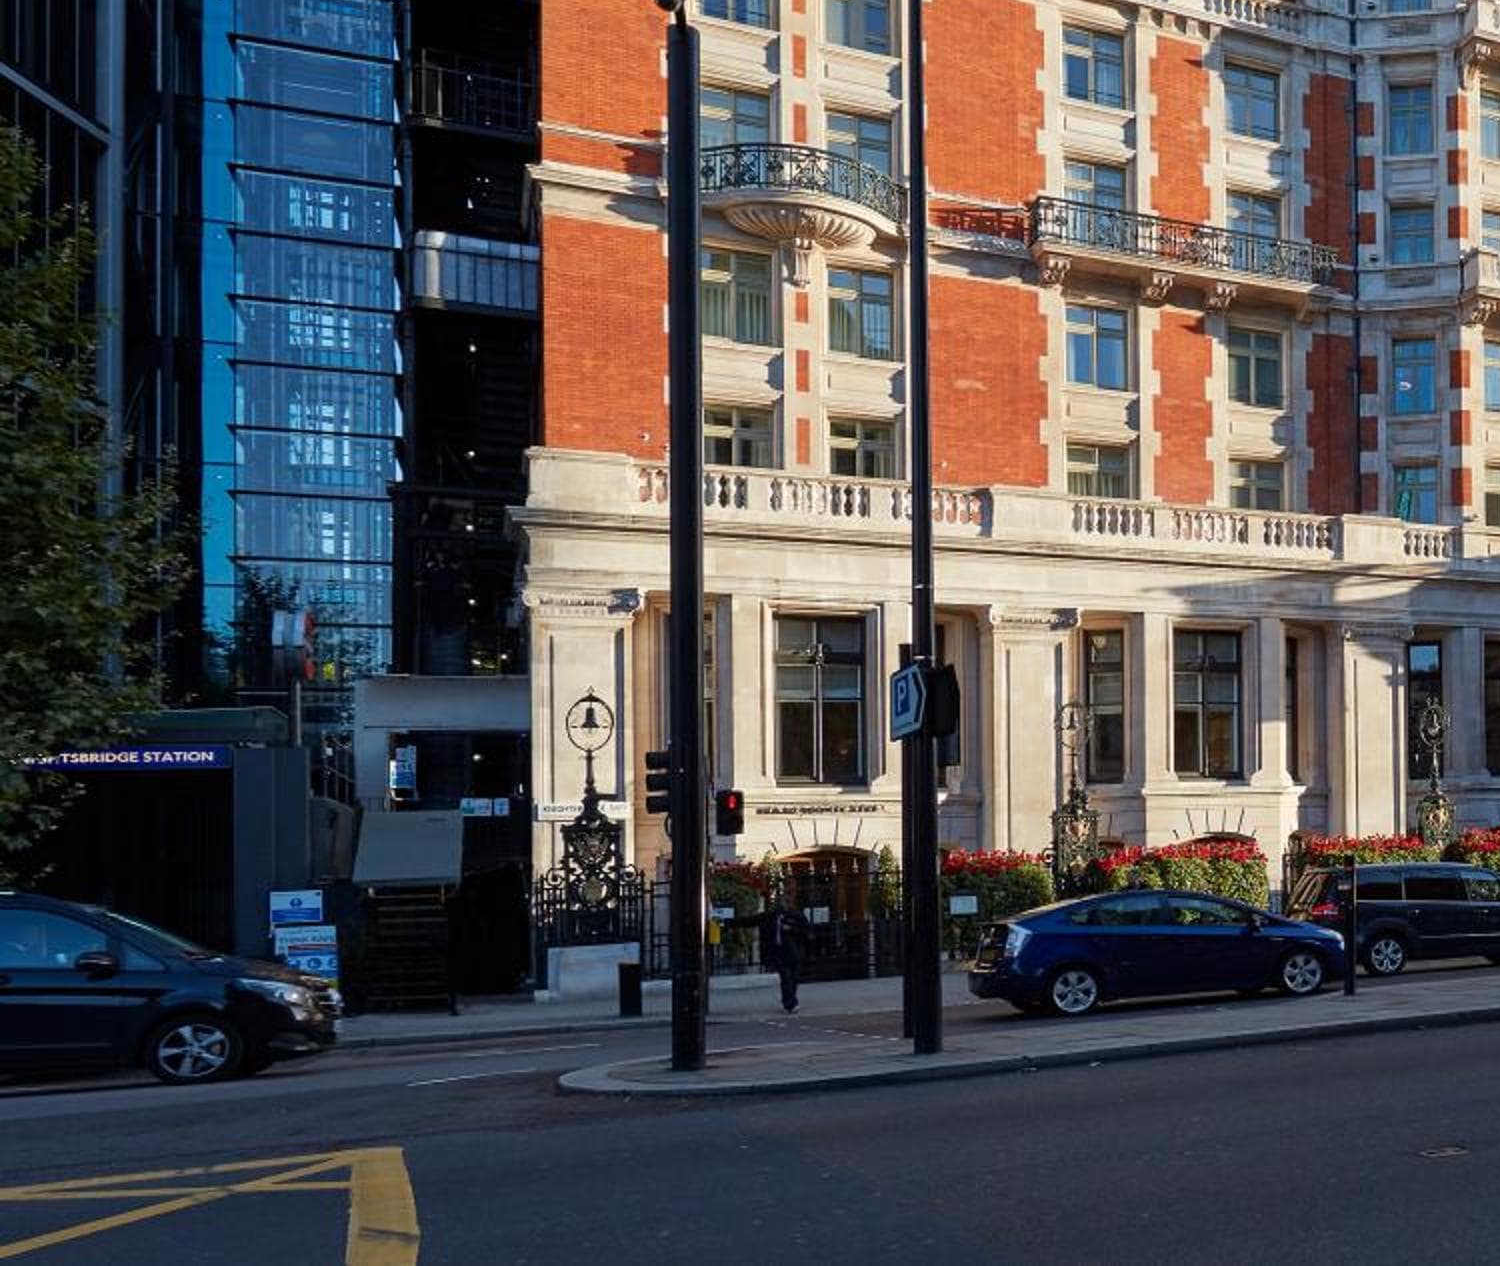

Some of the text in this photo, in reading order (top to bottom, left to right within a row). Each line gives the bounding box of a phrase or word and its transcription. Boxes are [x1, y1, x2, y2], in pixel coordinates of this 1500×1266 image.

[897, 679, 907, 714] P
[10, 750, 215, 765] TSBRIDGE STATION
